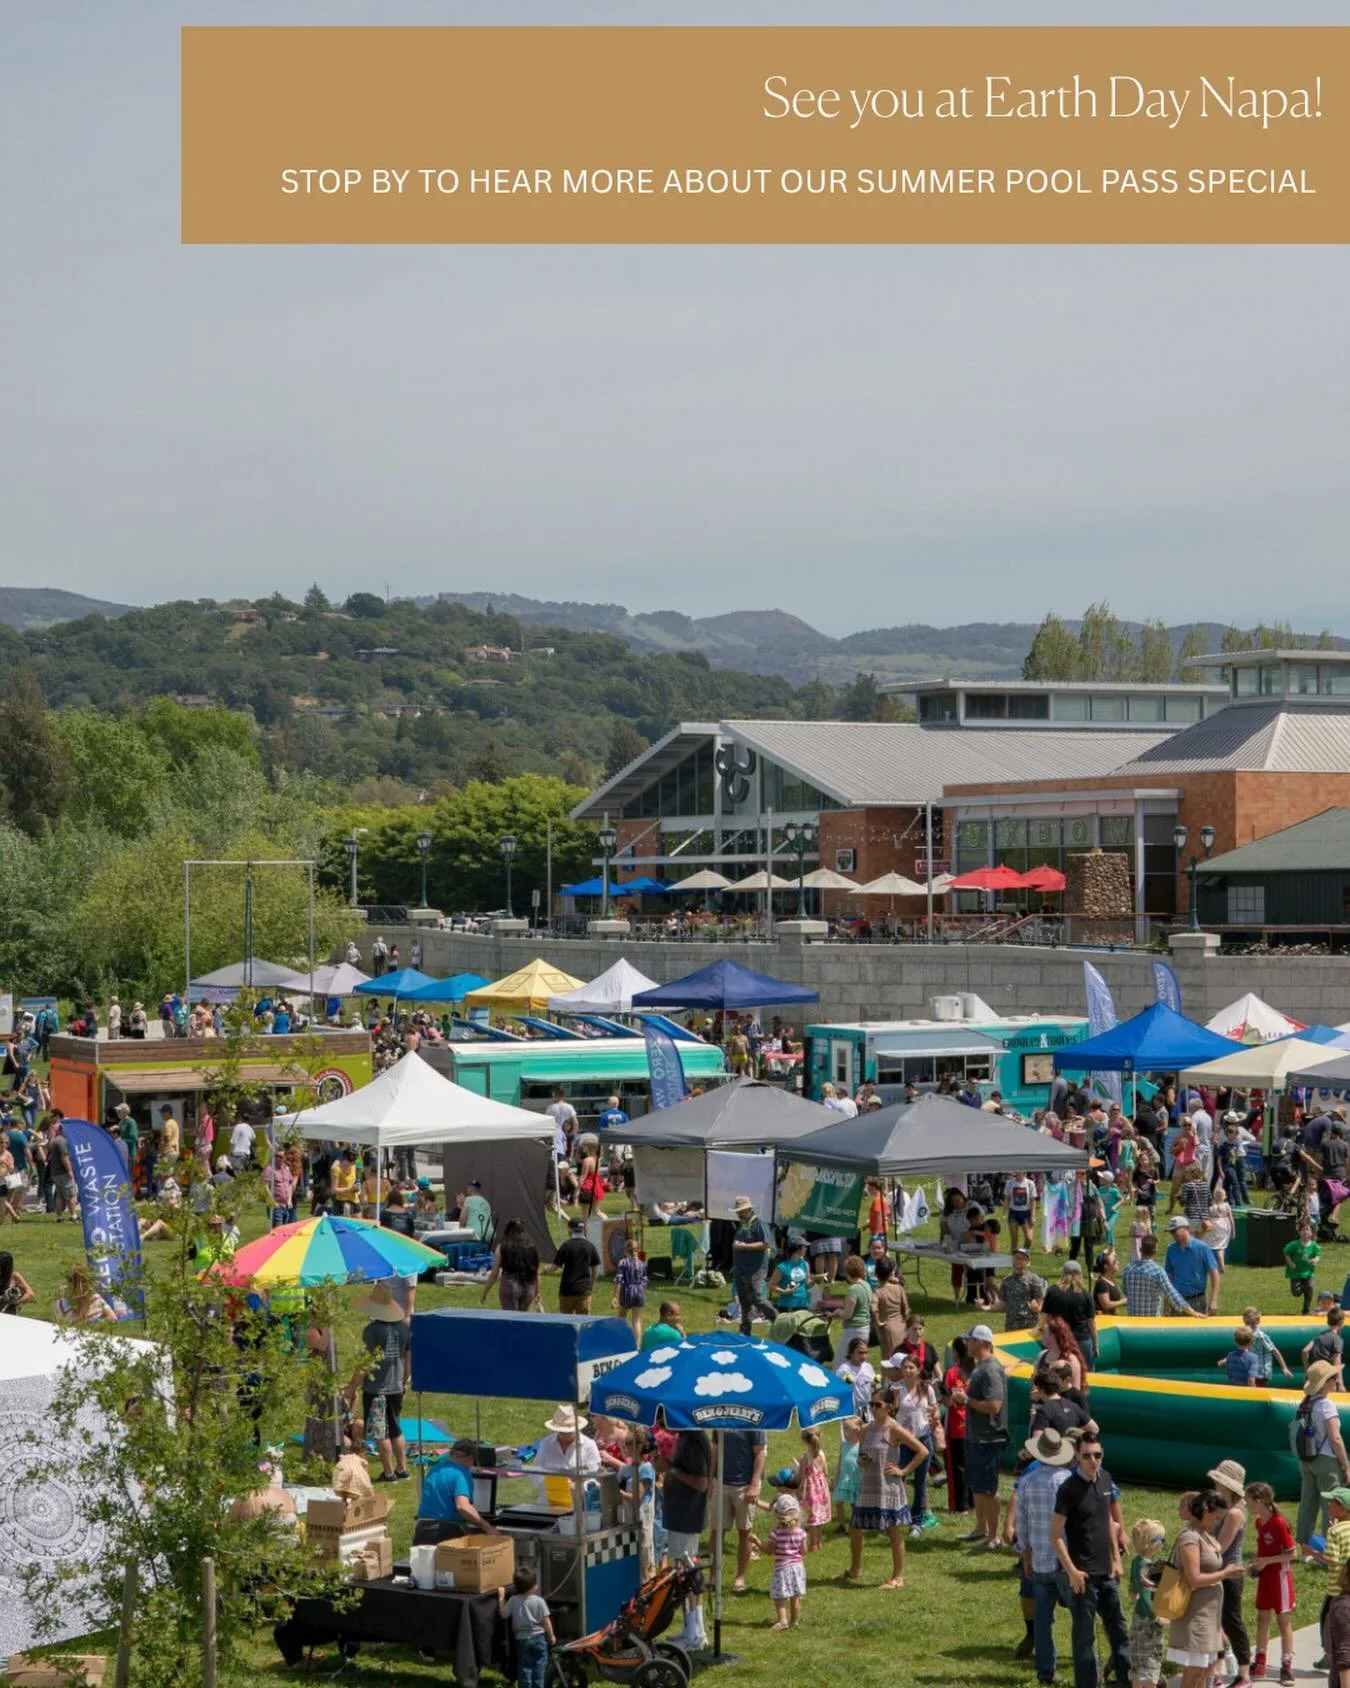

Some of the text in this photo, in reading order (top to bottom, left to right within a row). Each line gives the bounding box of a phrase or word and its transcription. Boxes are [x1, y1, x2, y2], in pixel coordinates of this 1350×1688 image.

[75, 1142, 101, 1216] WASTE
[695, 1408, 715, 1421] BEN
[723, 1406, 761, 1422] JERRY'S
